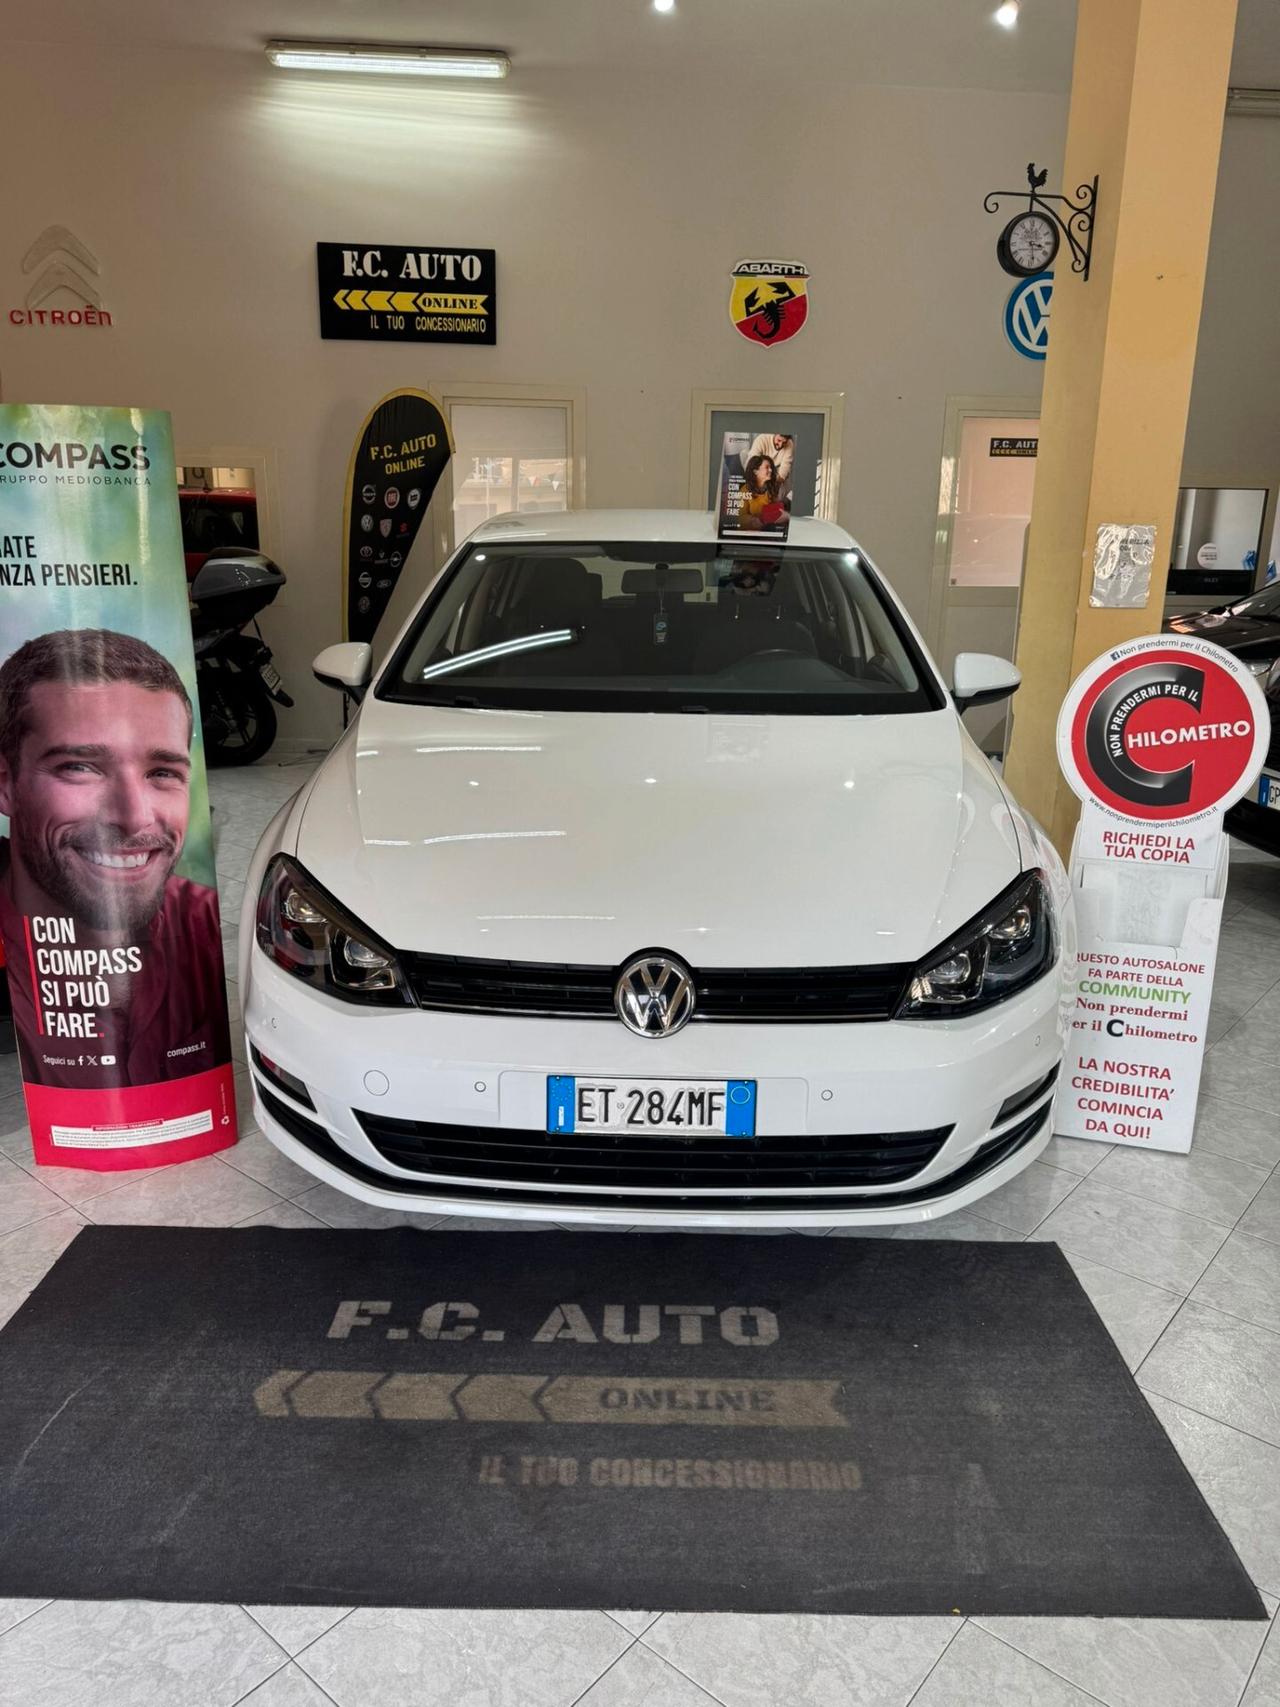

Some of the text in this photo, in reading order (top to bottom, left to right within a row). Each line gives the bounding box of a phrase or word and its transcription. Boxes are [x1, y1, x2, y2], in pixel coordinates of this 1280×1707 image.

[342, 250, 482, 282] F.C. AUTO
[738, 263, 805, 275] ABARTH
[422, 297, 478, 311] ONLINE
[370, 315, 487, 333] IL TUO CONCESSIONARIO
[0, 441, 150, 471] OMPASS
[370, 434, 436, 460] F.C. AUTO
[1015, 441, 1037, 449] AUT
[384, 456, 425, 475] ONLINE
[0, 474, 151, 486] RUPPO MEDIOBANCA
[727, 491, 752, 500] COMPASS
[0, 535, 37, 558] ATE
[41, 563, 138, 586] PENSIERI.
[1119, 646, 1137, 656] Non
[1137, 640, 1179, 651] prendermi
[1180, 641, 1195, 649] per
[1201, 645, 1239, 673] Chilometro
[1109, 684, 1199, 758] NON PRENDERMI PER IL
[1103, 831, 1195, 850] RICHIEDI LA
[1105, 844, 1190, 864] TUA COPIA
[32, 916, 76, 944] CON
[37, 946, 142, 976] COMPASS
[1122, 957, 1206, 974] AUTOSALONE
[1088, 968, 1183, 987] FA PARTE DELLA
[41, 976, 110, 1007] SI PUÒ
[1079, 980, 1192, 1004] COMMUNITY
[1076, 996, 1189, 1021] Non prendermi
[44, 1011, 104, 1038] FARE.
[1072, 1019, 1198, 1043] er il Chilometro
[43, 1054, 75, 1066] Seguici su
[166, 1041, 206, 1058] compass.it
[1078, 1056, 1172, 1080] LA NOSTRA
[578, 1088, 616, 1123] ET
[627, 1089, 726, 1126] 284MF
[1077, 1097, 1164, 1121] COMINCIA
[1085, 1118, 1151, 1139] DA QUI!
[327, 1301, 780, 1346] F.C. AUTO
[600, 1387, 777, 1412] ONLINE
[479, 1455, 863, 1491] IL TUO CONCESSIONARIO
